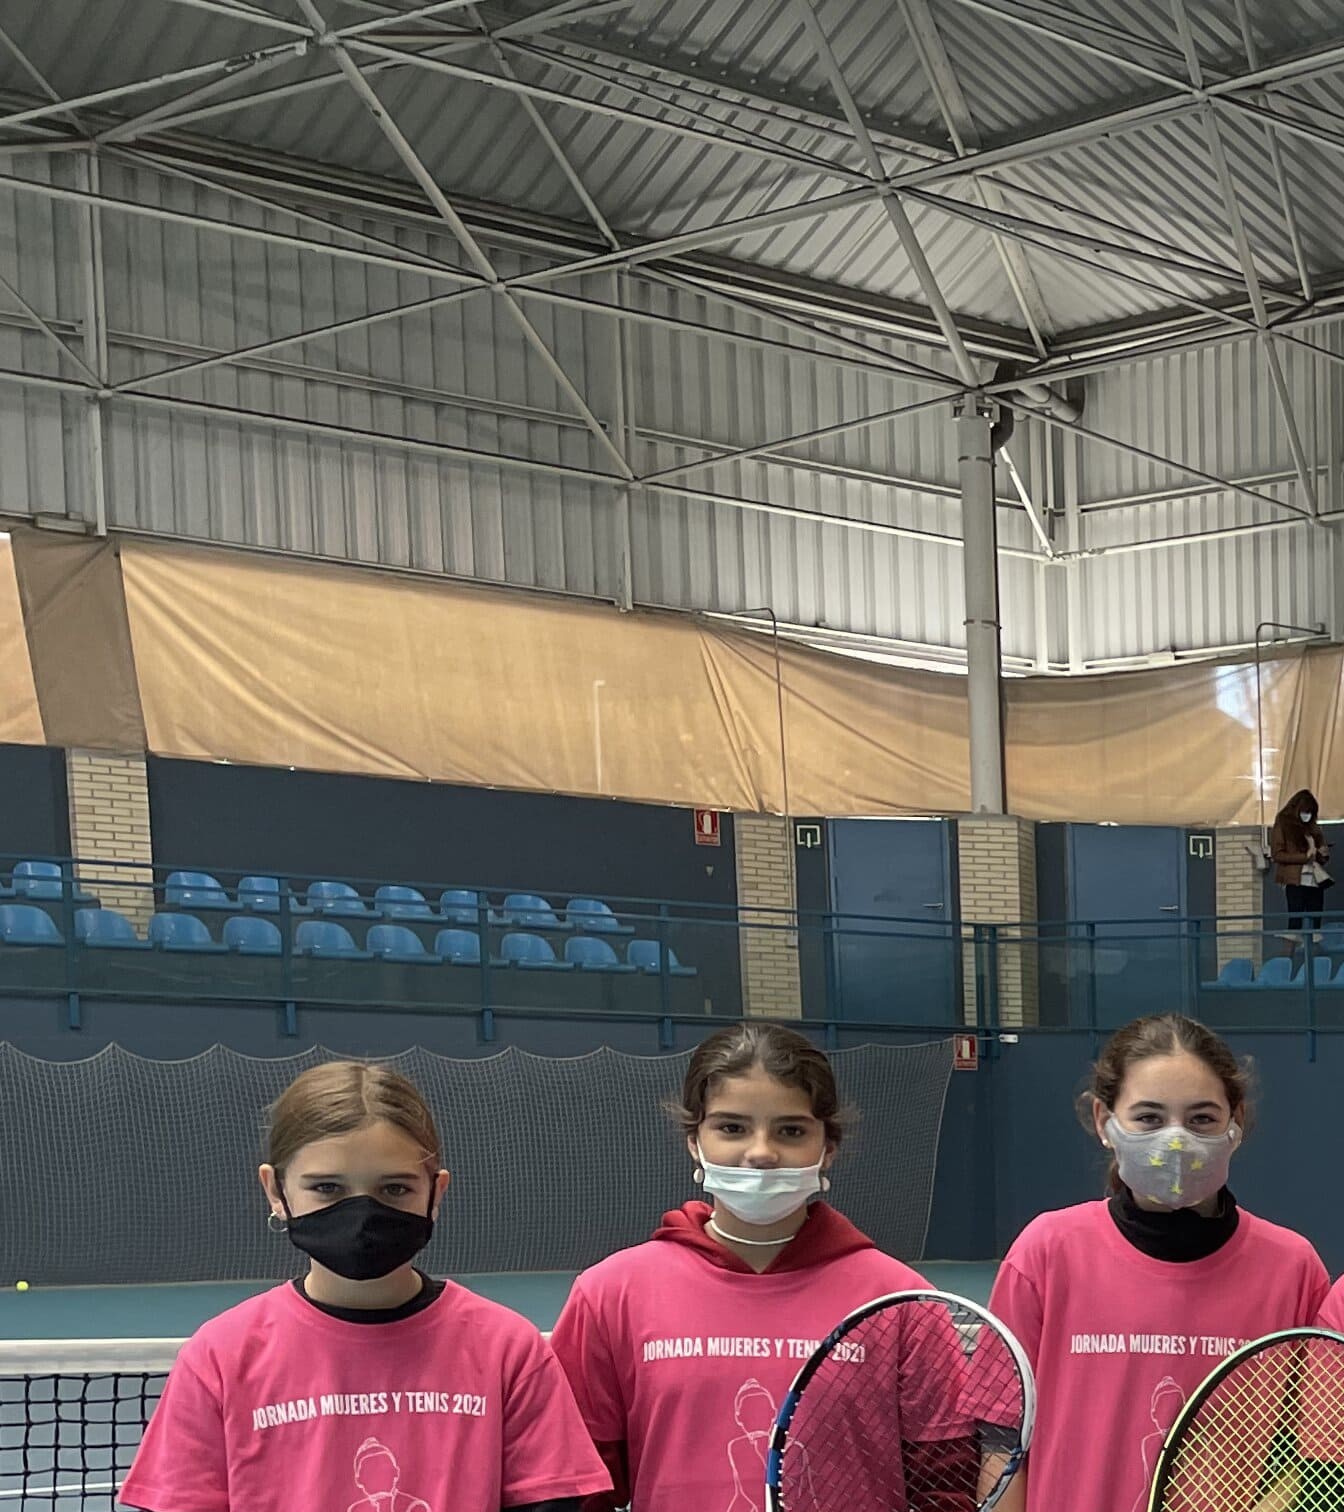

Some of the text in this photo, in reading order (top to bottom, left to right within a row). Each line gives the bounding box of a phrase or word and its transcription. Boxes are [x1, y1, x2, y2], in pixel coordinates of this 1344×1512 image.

[643, 1337, 866, 1363] JORNADA MUJERES Y TEN 2021
[1070, 1334, 1126, 1354] JORNADA
[1129, 1334, 1186, 1355] MUJERES
[1189, 1336, 1198, 1355] Y
[1200, 1336, 1236, 1358] TENIS
[253, 1391, 487, 1431] JORNADA MUJERES Y TENIS 2021
